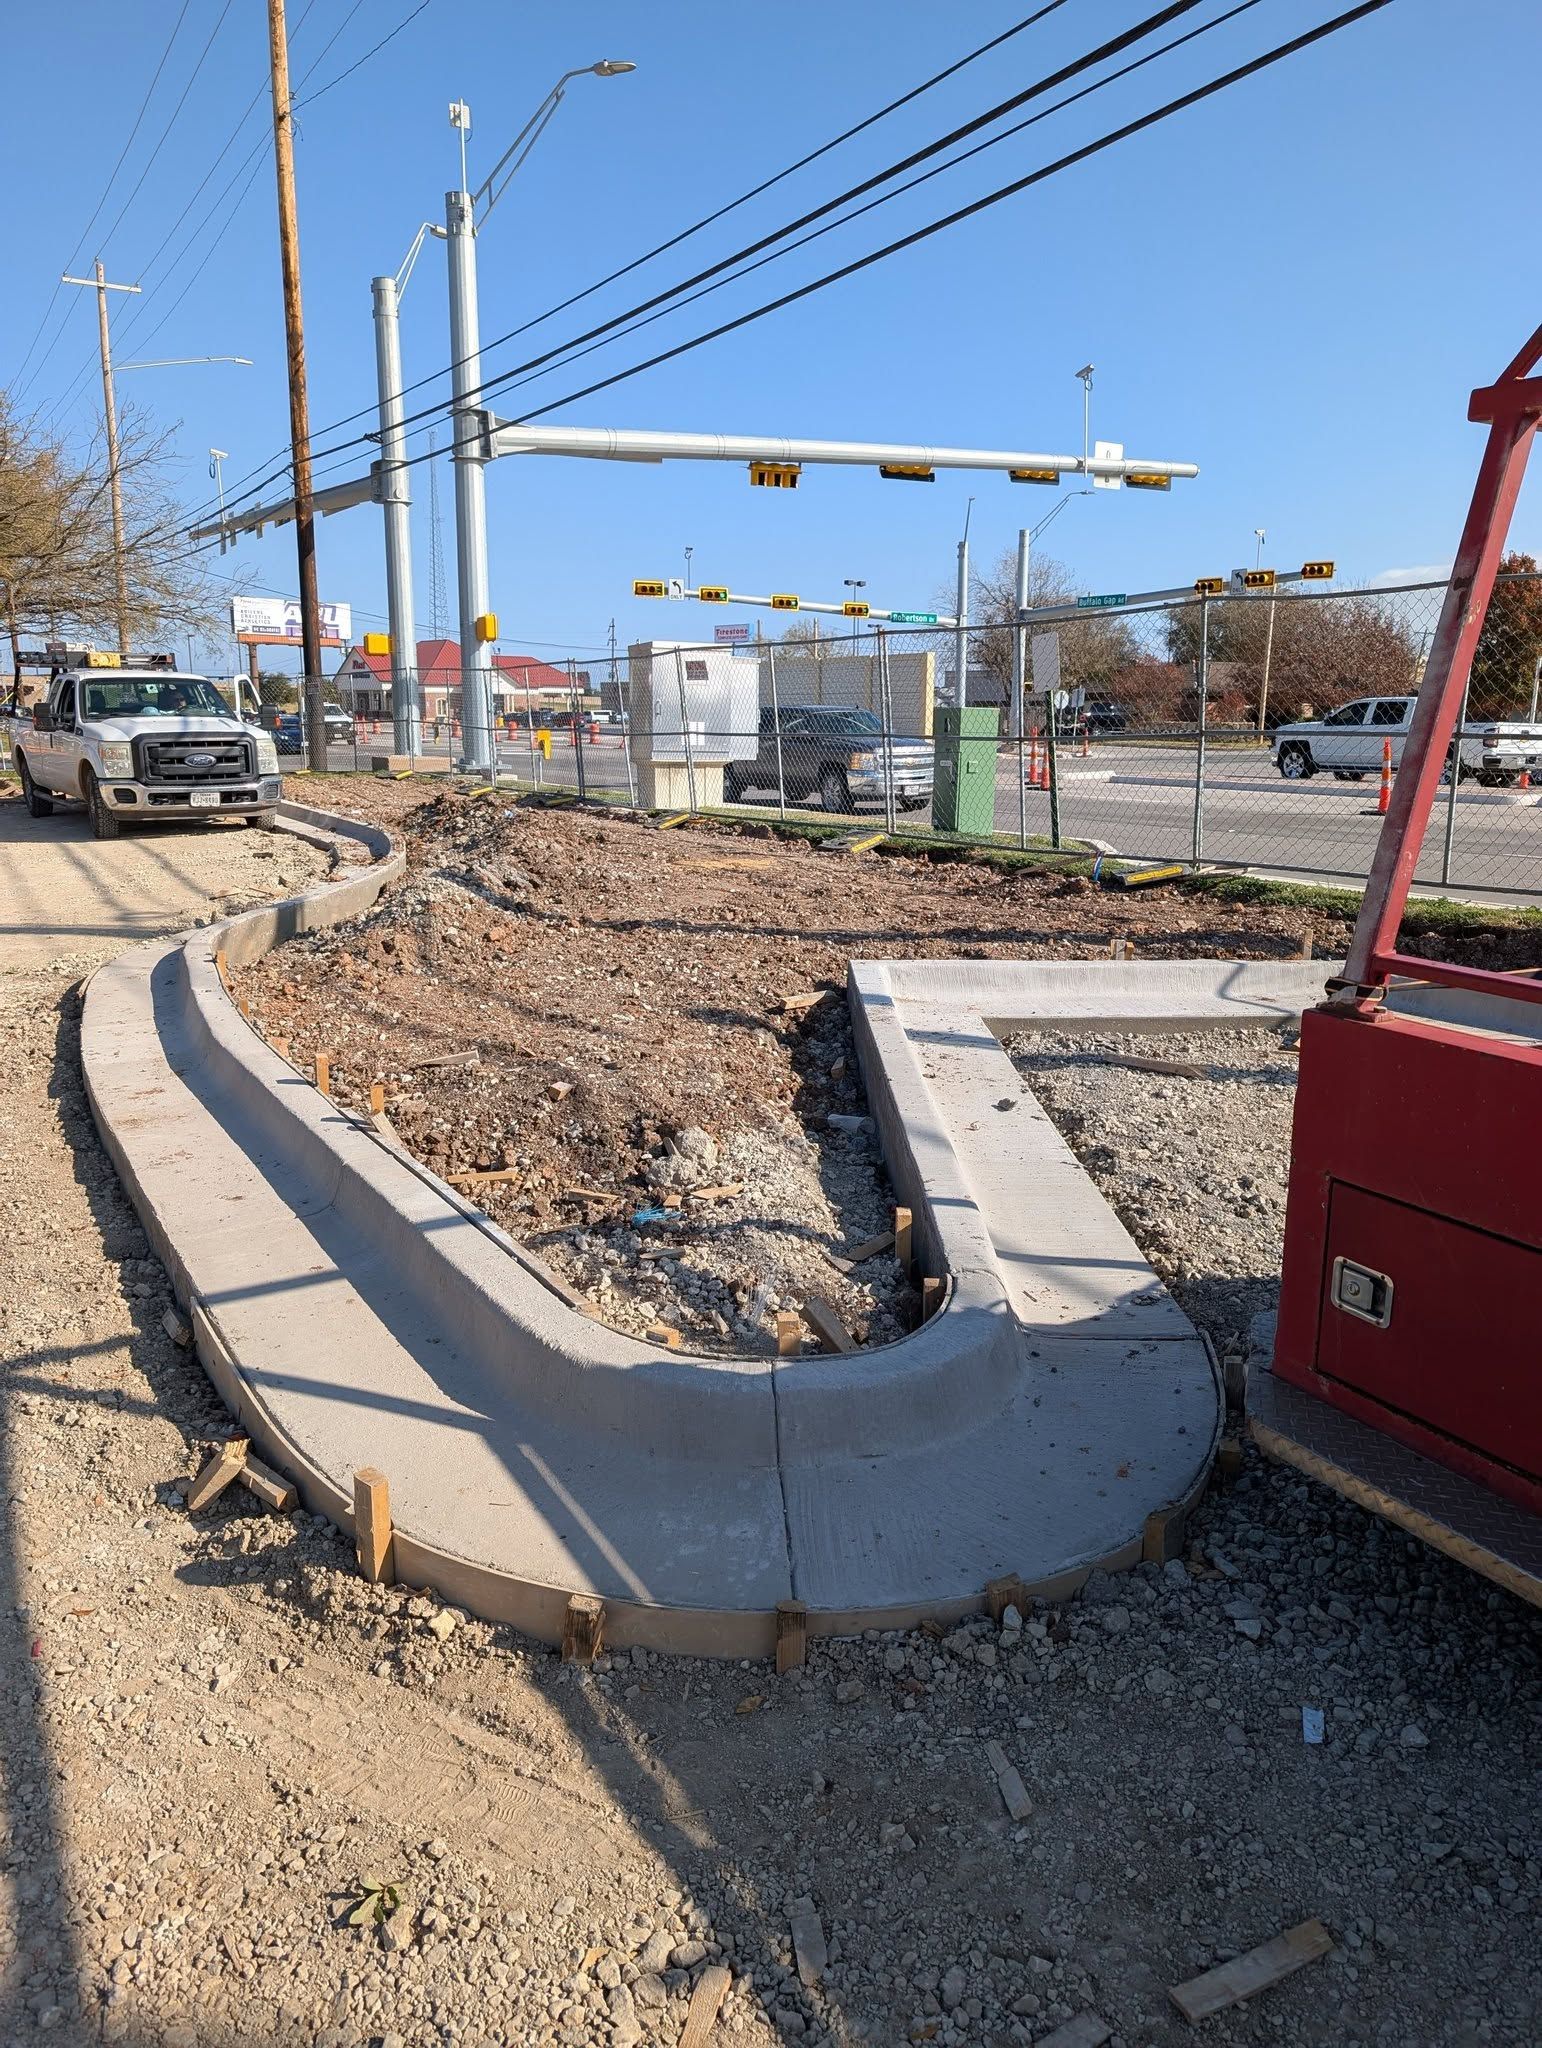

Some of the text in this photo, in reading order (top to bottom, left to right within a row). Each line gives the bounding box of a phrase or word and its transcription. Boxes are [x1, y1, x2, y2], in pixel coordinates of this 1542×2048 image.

[1079, 598, 1102, 607] Buffalo
[1103, 596, 1116, 605] Gap
[892, 613, 928, 622] Robertson
[716, 628, 748, 636] Firestone
